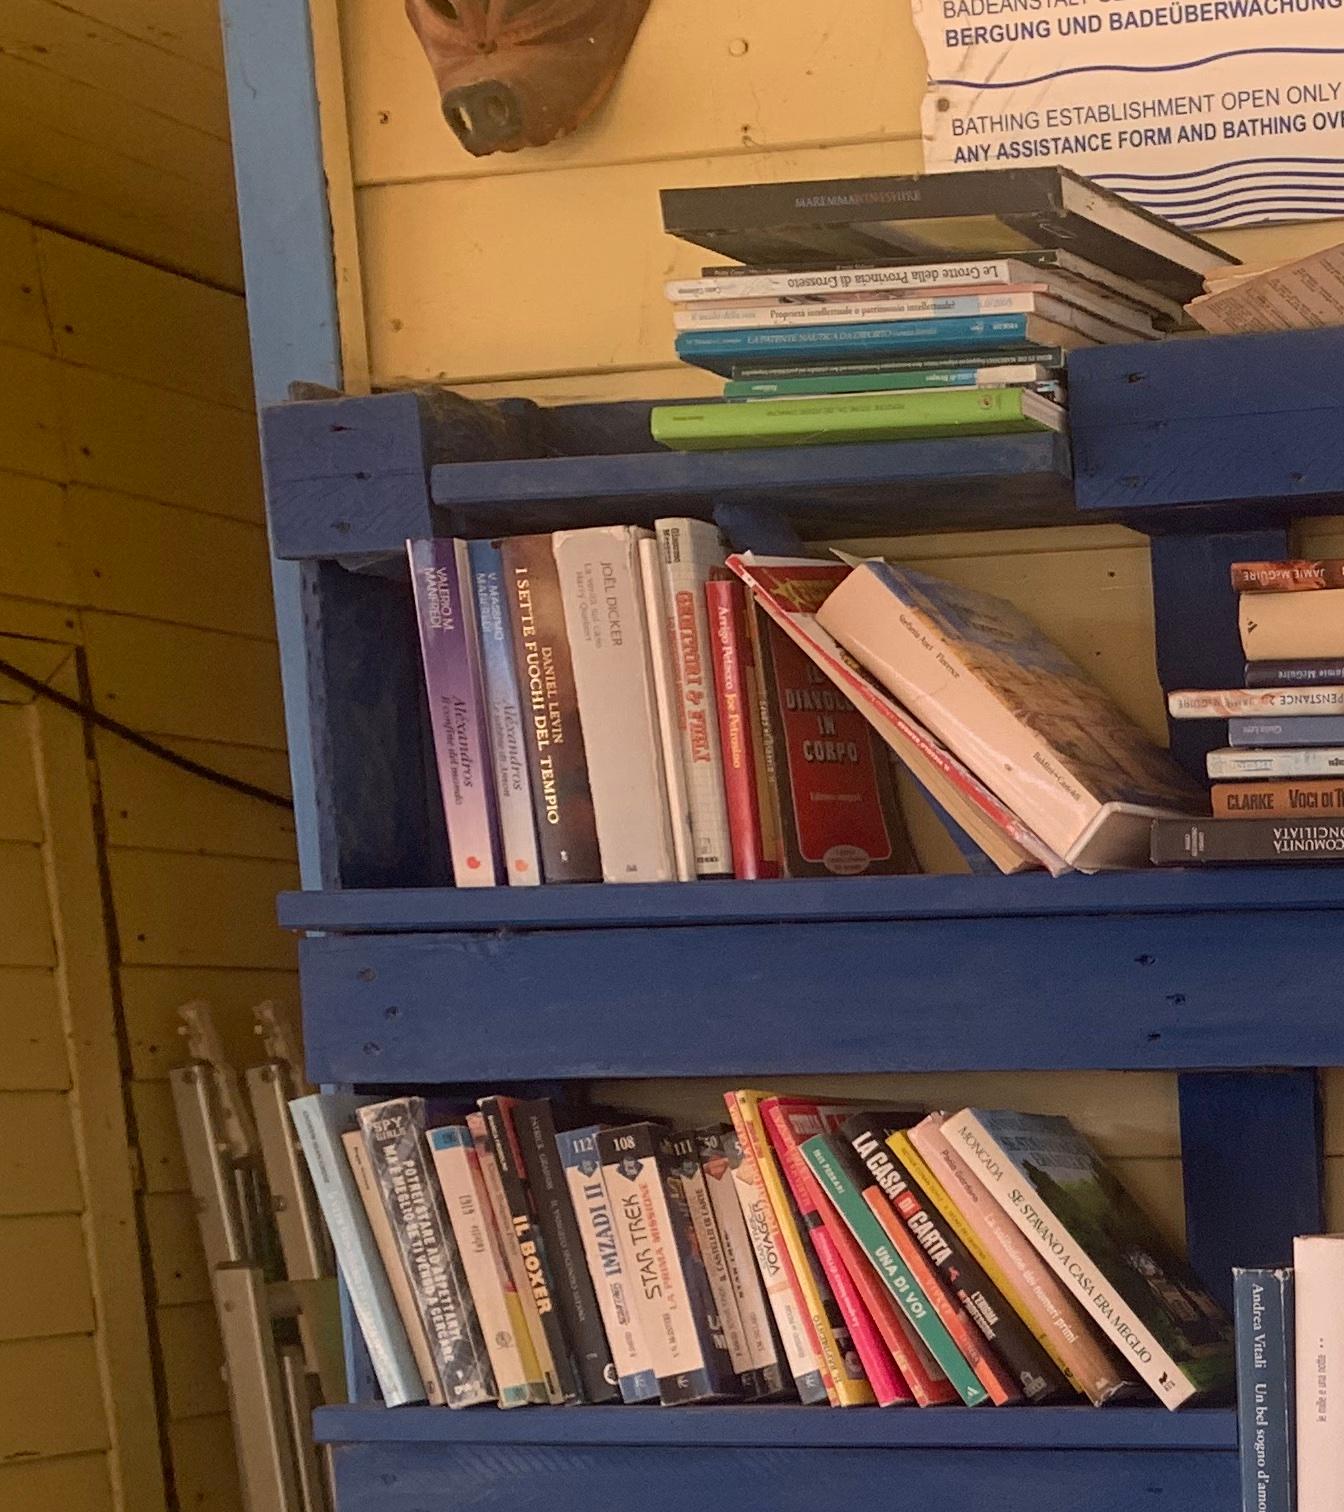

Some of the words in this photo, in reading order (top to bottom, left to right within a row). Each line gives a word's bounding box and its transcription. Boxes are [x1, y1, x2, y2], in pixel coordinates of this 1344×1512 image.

[945, 20, 1051, 47] BERGUNG
[1058, 15, 1101, 36] UND
[953, 111, 1040, 136] BATHING
[1047, 94, 1215, 128] ESTABLISHMENT
[1221, 88, 1280, 111] OPEN
[1287, 82, 1342, 105] ONLY
[954, 145, 990, 164] ANY
[997, 133, 1112, 160] ASSISTANCE
[1118, 125, 1172, 149] FORM
[1177, 123, 1217, 143] AND
[1223, 114, 1306, 139] BATHING
[787, 274, 838, 291] Grosseto
[840, 273, 851, 288] di
[855, 270, 908, 287] Provincia
[911, 267, 938, 285] della
[941, 265, 980, 281] Grotte
[982, 263, 998, 279] Le
[516, 580, 536, 637] SETTE
[525, 642, 545, 714] FUOCHI
[542, 647, 558, 698] DANIEL
[534, 716, 549, 751] DEL
[549, 702, 563, 744] LEVIN
[539, 754, 560, 824] TEMPIO
[1227, 788, 1274, 810] CLARKE
[1288, 787, 1319, 809] VOCI
[1320, 788, 1333, 808] DI
[572, 1140, 593, 1153] 112
[613, 1136, 635, 1151] 108
[957, 1122, 1006, 1184] MONCADA
[852, 1131, 875, 1157] LA
[864, 1150, 906, 1200] CASA
[898, 1196, 914, 1214] DI
[907, 1211, 953, 1267] CARTA
[1007, 1187, 1026, 1207] SE
[513, 1216, 529, 1236] IL
[622, 1194, 647, 1246] TREK
[1018, 1201, 1066, 1259] STAVANO
[592, 1206, 622, 1276] IMZADI
[1058, 1251, 1073, 1265] A
[520, 1241, 553, 1314] BOXER
[637, 1247, 663, 1301] STAR
[1065, 1259, 1098, 1298] CASA
[1091, 1291, 1118, 1321] ERA
[1251, 1283, 1265, 1333] Andrea
[1109, 1313, 1153, 1367] MEGLIO
[1253, 1335, 1267, 1369] Vitali
[1254, 1384, 1266, 1401] Un
[1255, 1406, 1267, 1423] bel
[1254, 1425, 1267, 1465] sogno
